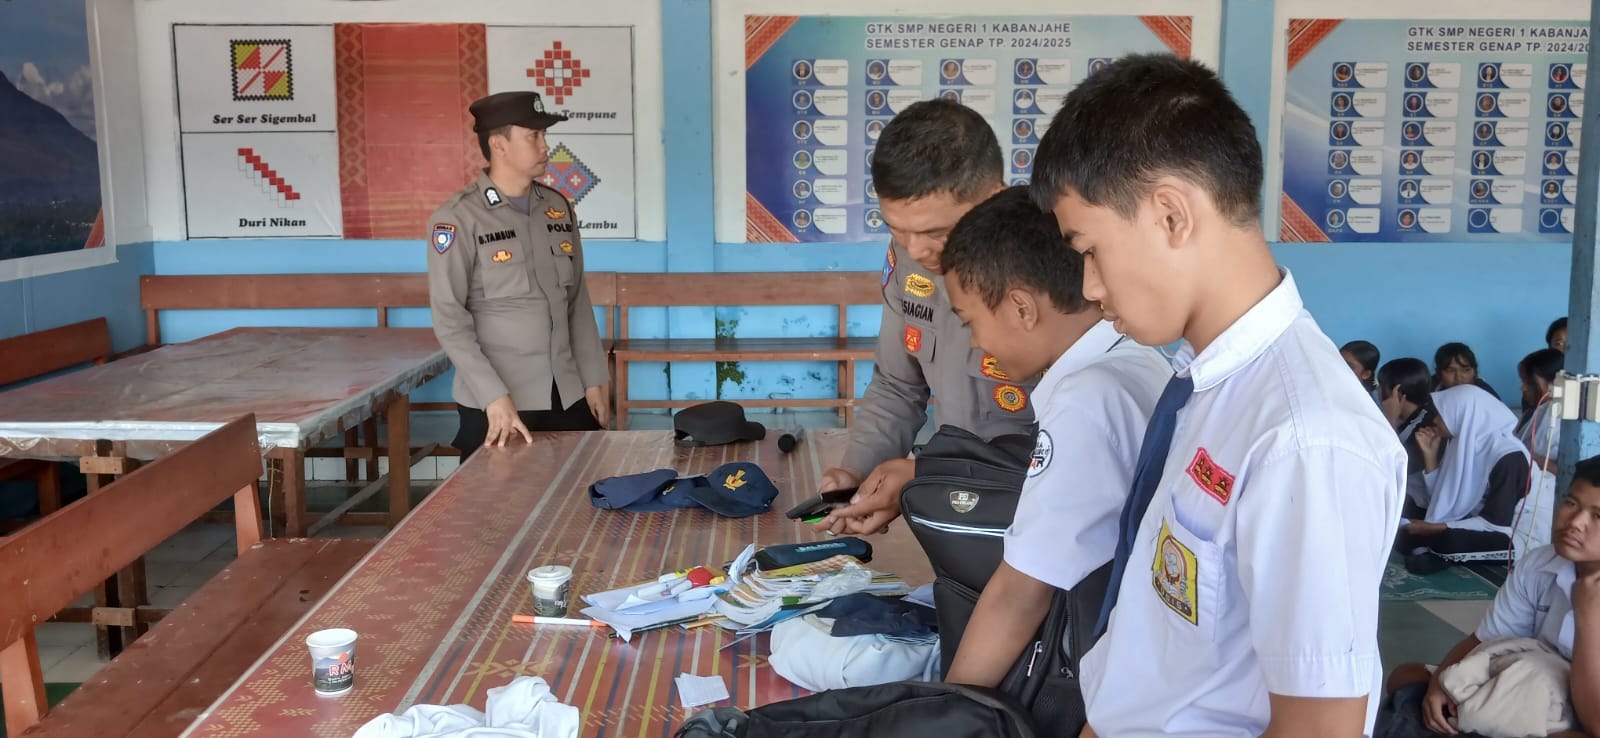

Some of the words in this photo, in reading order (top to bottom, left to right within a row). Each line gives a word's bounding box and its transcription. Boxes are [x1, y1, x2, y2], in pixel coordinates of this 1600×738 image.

[866, 23, 893, 34] GTK
[897, 23, 924, 34] SMP
[928, 23, 977, 33] NEGERI
[981, 23, 987, 33] 1
[992, 23, 1071, 33] KABANJAHE
[1408, 26, 1434, 37] GTK
[1438, 26, 1465, 37] SMP
[1468, 27, 1515, 37] NEGERI
[1520, 27, 1525, 37] 1
[1530, 28, 1589, 38] KABANJA
[866, 38, 935, 49] SEMESTER
[940, 38, 985, 48] GENAP
[989, 38, 1006, 48] TP.
[1010, 37, 1072, 48] 2024/2025
[1407, 41, 1475, 51] SEMESTER
[1479, 41, 1522, 51] GENAP
[1547, 42, 1590, 53] 2024/20
[212, 114, 234, 124] Ser
[236, 114, 258, 124] Ser
[260, 113, 317, 125] Sigembal
[561, 109, 617, 121] Tempune
[239, 217, 267, 228] Duri
[270, 217, 307, 227] Nikan
[577, 220, 618, 230] Lembu
